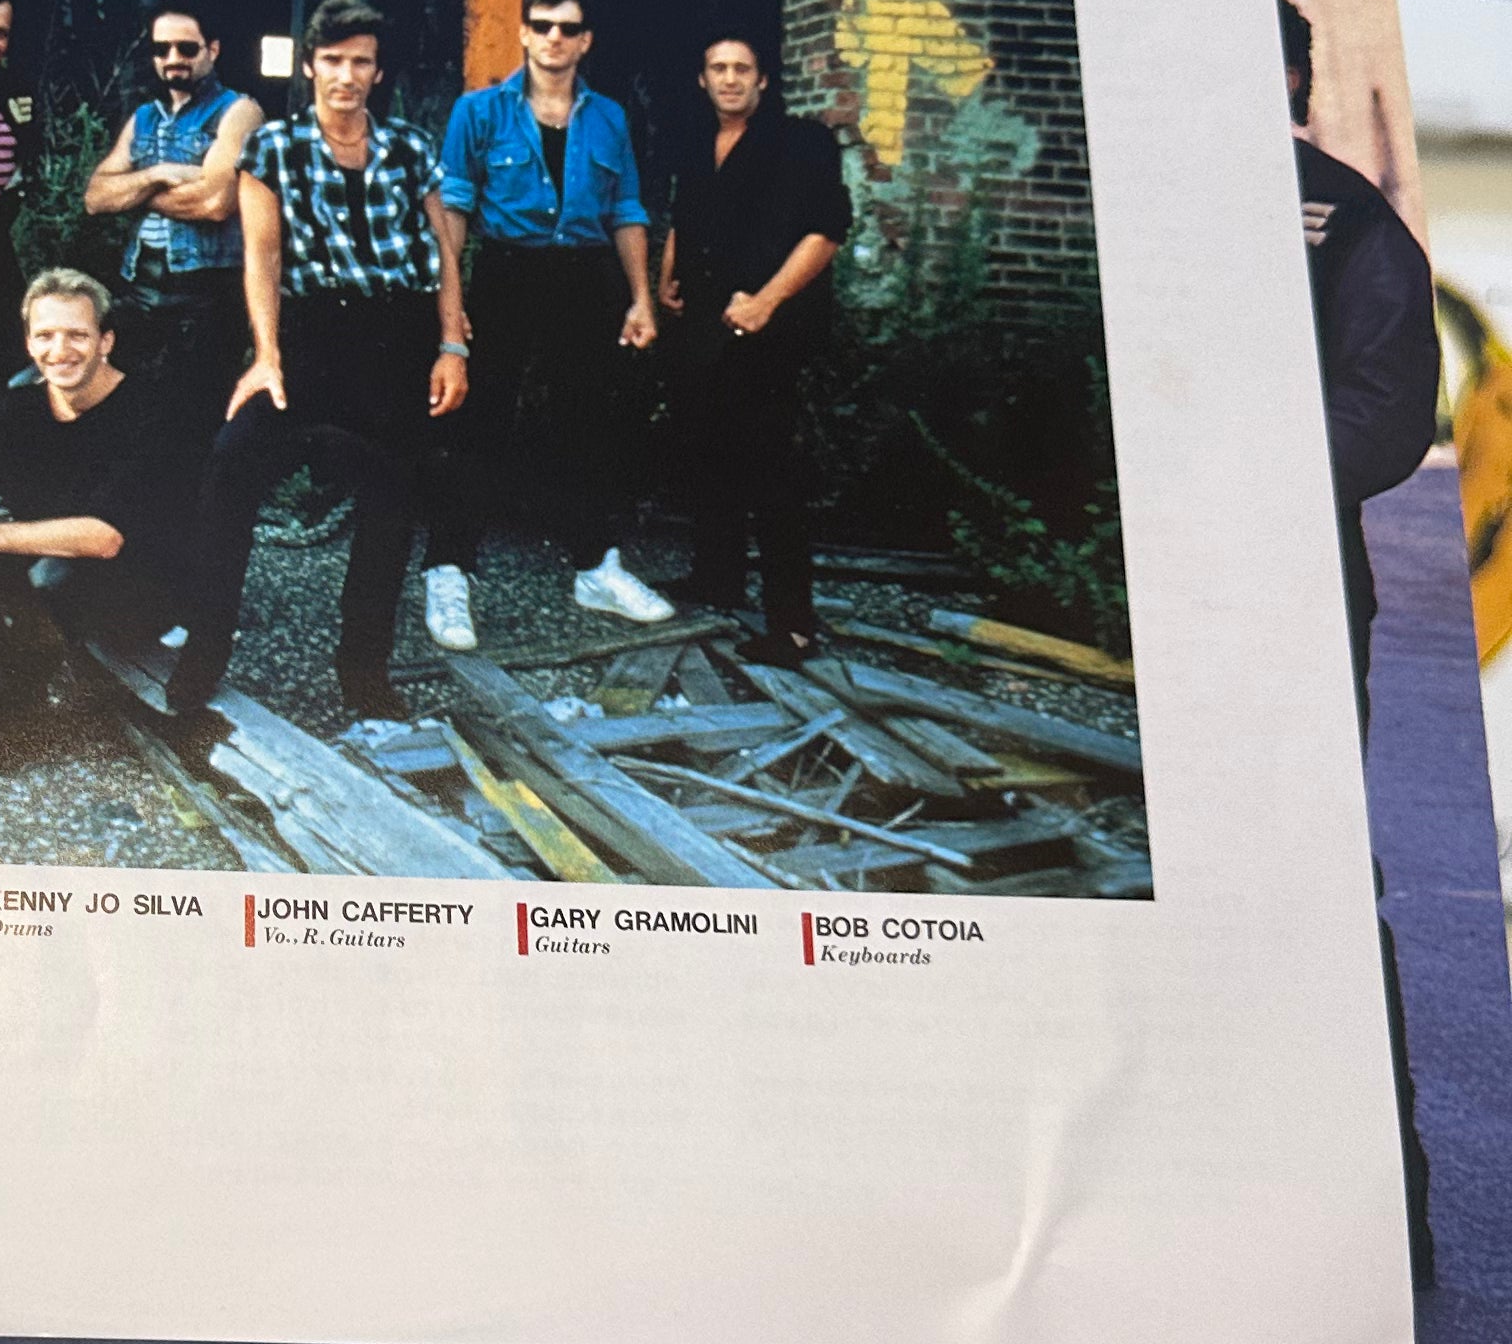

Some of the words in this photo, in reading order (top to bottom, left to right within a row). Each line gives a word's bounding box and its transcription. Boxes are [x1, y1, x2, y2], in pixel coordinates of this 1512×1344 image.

[85, 892, 121, 916] JO
[133, 894, 204, 918] SILVA
[256, 897, 329, 922] JOHN
[341, 900, 474, 926] CAFFERTY
[529, 906, 602, 931] GARY
[614, 909, 758, 936] GRAMOLINI
[815, 915, 870, 939] BOB
[881, 918, 985, 943] COTOIA
[534, 934, 611, 956] Guitars
[820, 944, 932, 967] Keyboards
